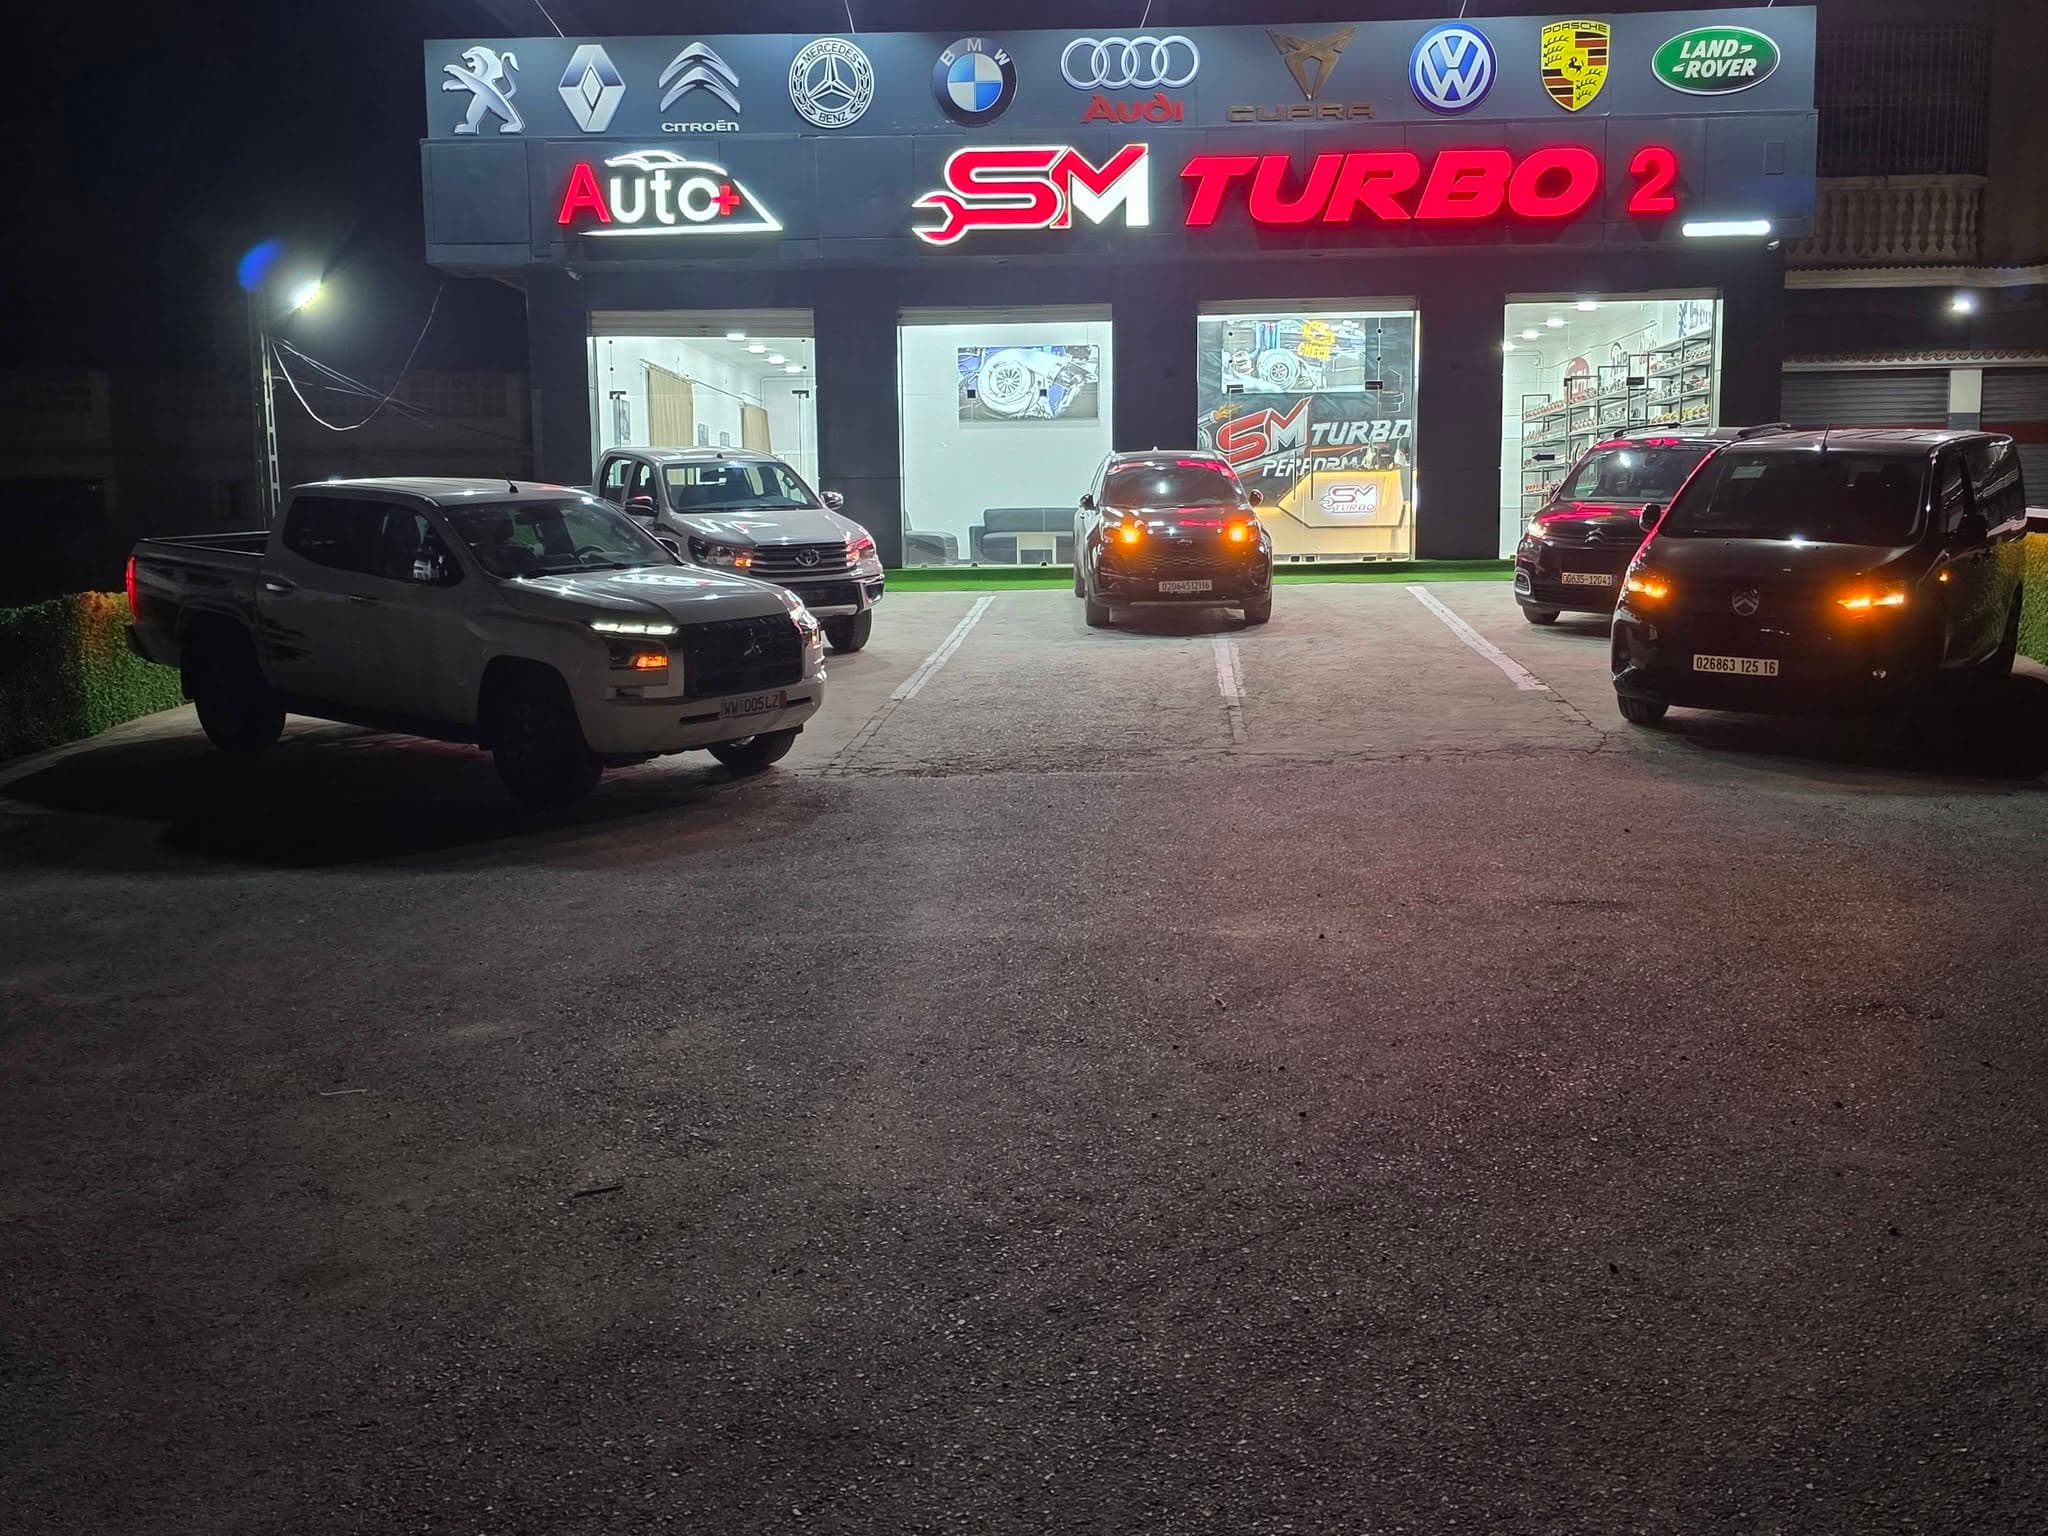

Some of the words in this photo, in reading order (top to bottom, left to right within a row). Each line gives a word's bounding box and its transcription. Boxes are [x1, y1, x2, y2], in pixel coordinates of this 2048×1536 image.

[1543, 22, 1608, 35] PORSCHE
[803, 43, 858, 64] MERCEDES
[940, 38, 1012, 66] BMW
[1679, 39, 1739, 58] LAND
[1685, 58, 1757, 79] ROVER
[818, 111, 849, 123] BENZ
[1082, 93, 1184, 123] Audi
[1226, 103, 1376, 122] CUPRA
[912, 143, 1150, 246] SM
[1179, 147, 1600, 226] TURBO
[1629, 146, 1677, 214] 2
[1216, 396, 1314, 465] SM
[1311, 419, 1413, 446] TURBO
[1696, 656, 1736, 672] 026863
[1740, 660, 1759, 673] 125
[1763, 661, 1776, 674] 16
